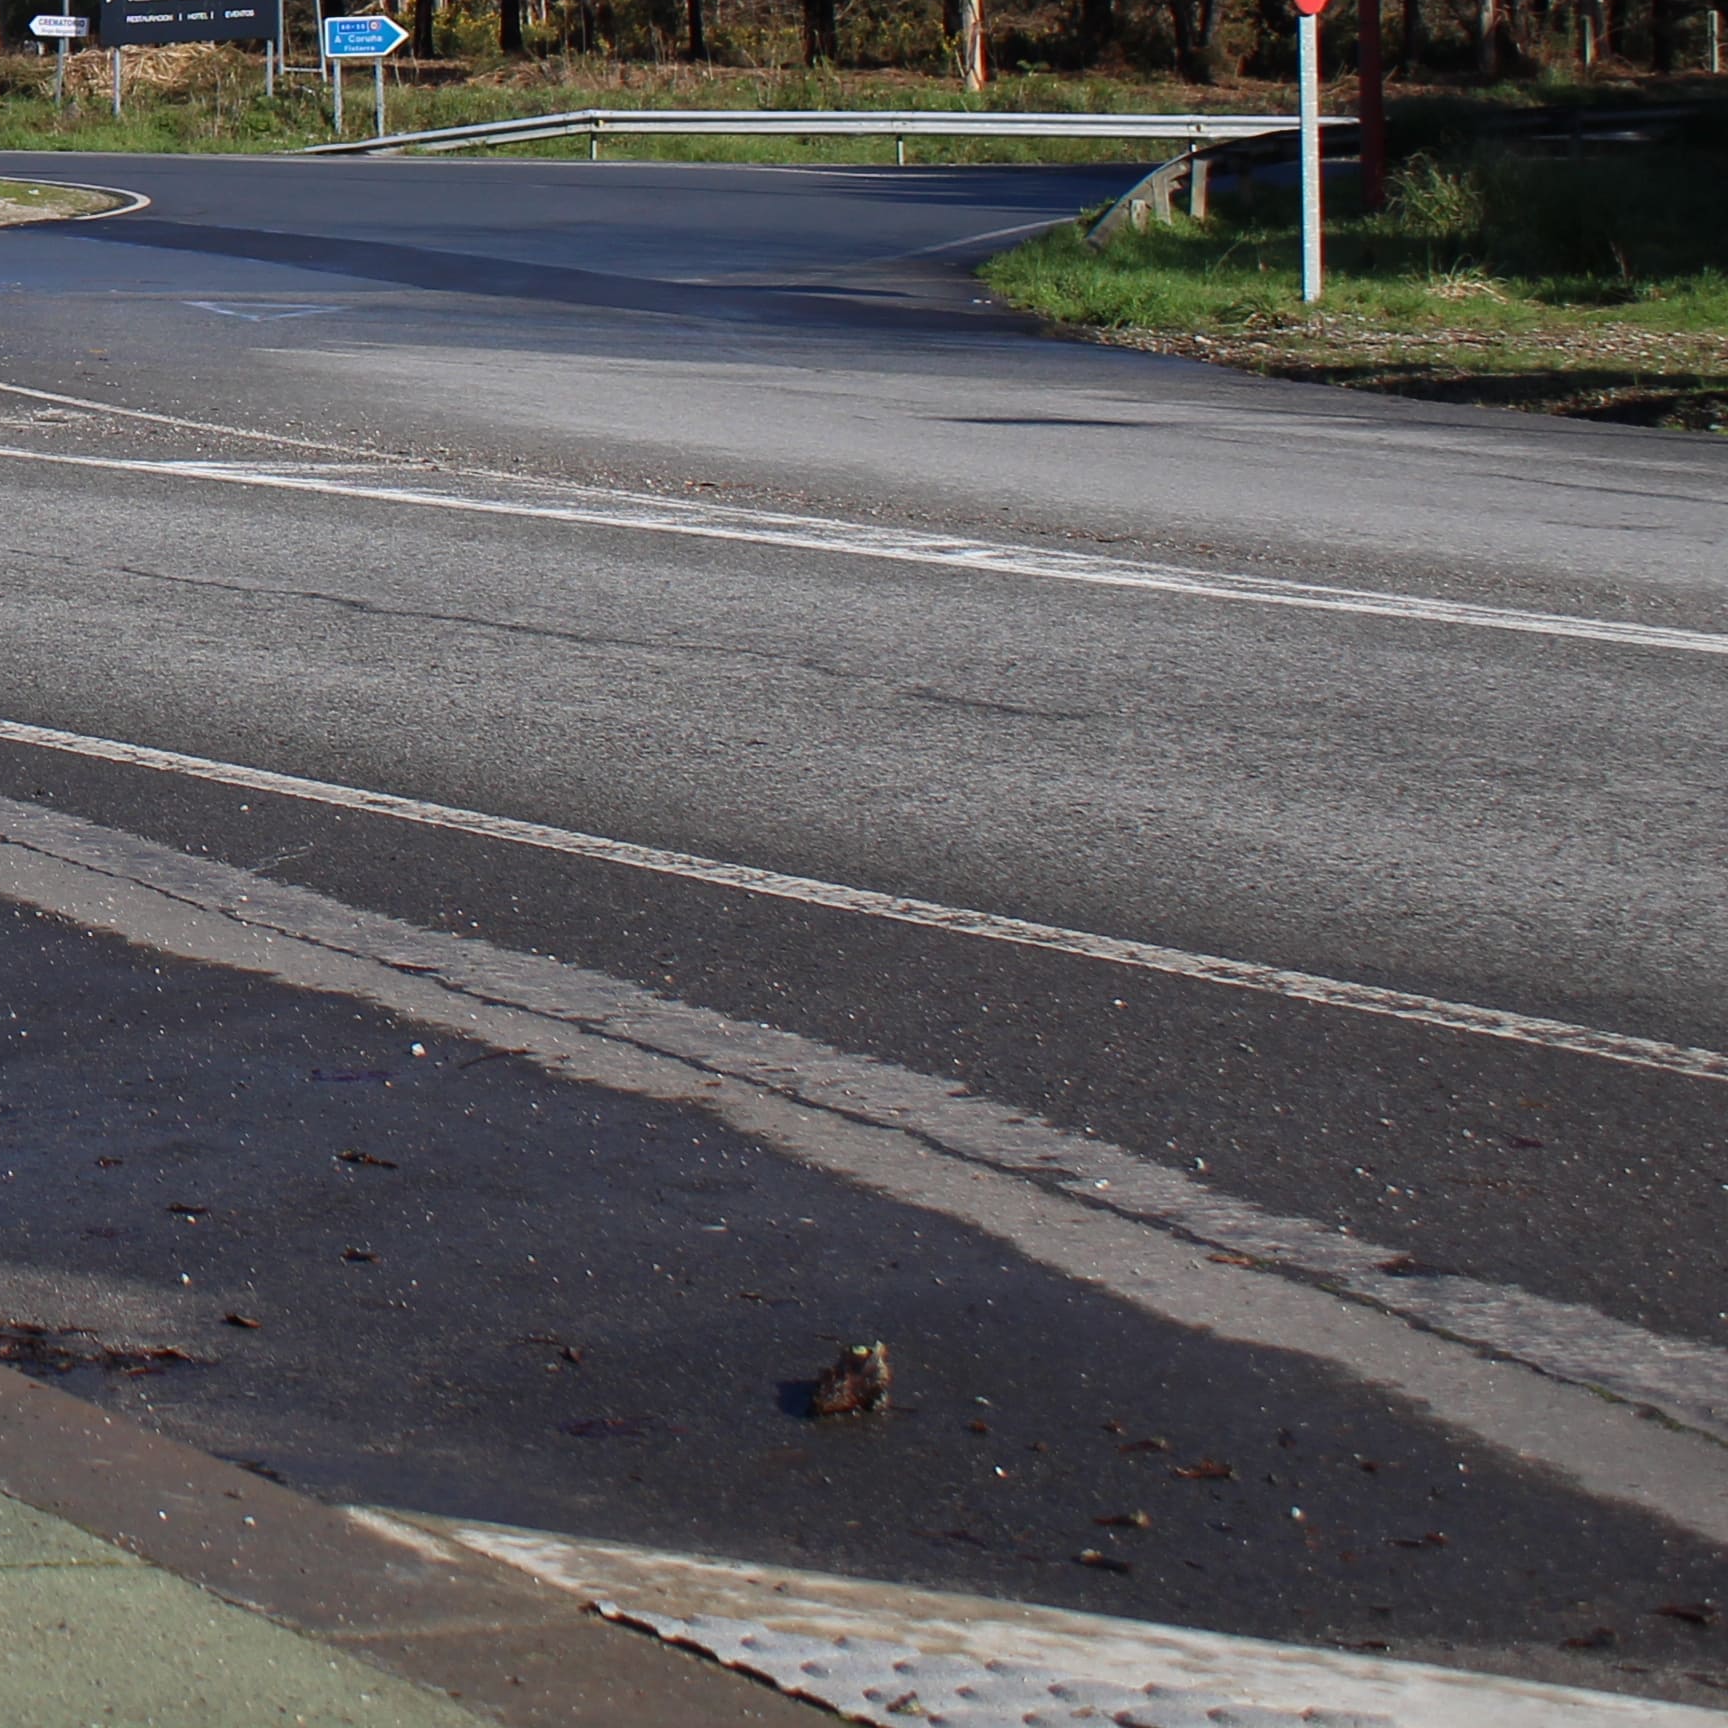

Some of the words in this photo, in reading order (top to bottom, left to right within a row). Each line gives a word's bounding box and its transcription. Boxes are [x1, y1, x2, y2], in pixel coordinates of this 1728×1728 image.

[186, 11, 209, 21] HOTEL
[224, 9, 255, 19] EVENTOS
[334, 35, 342, 43] A
[347, 34, 383, 43] Coruña
